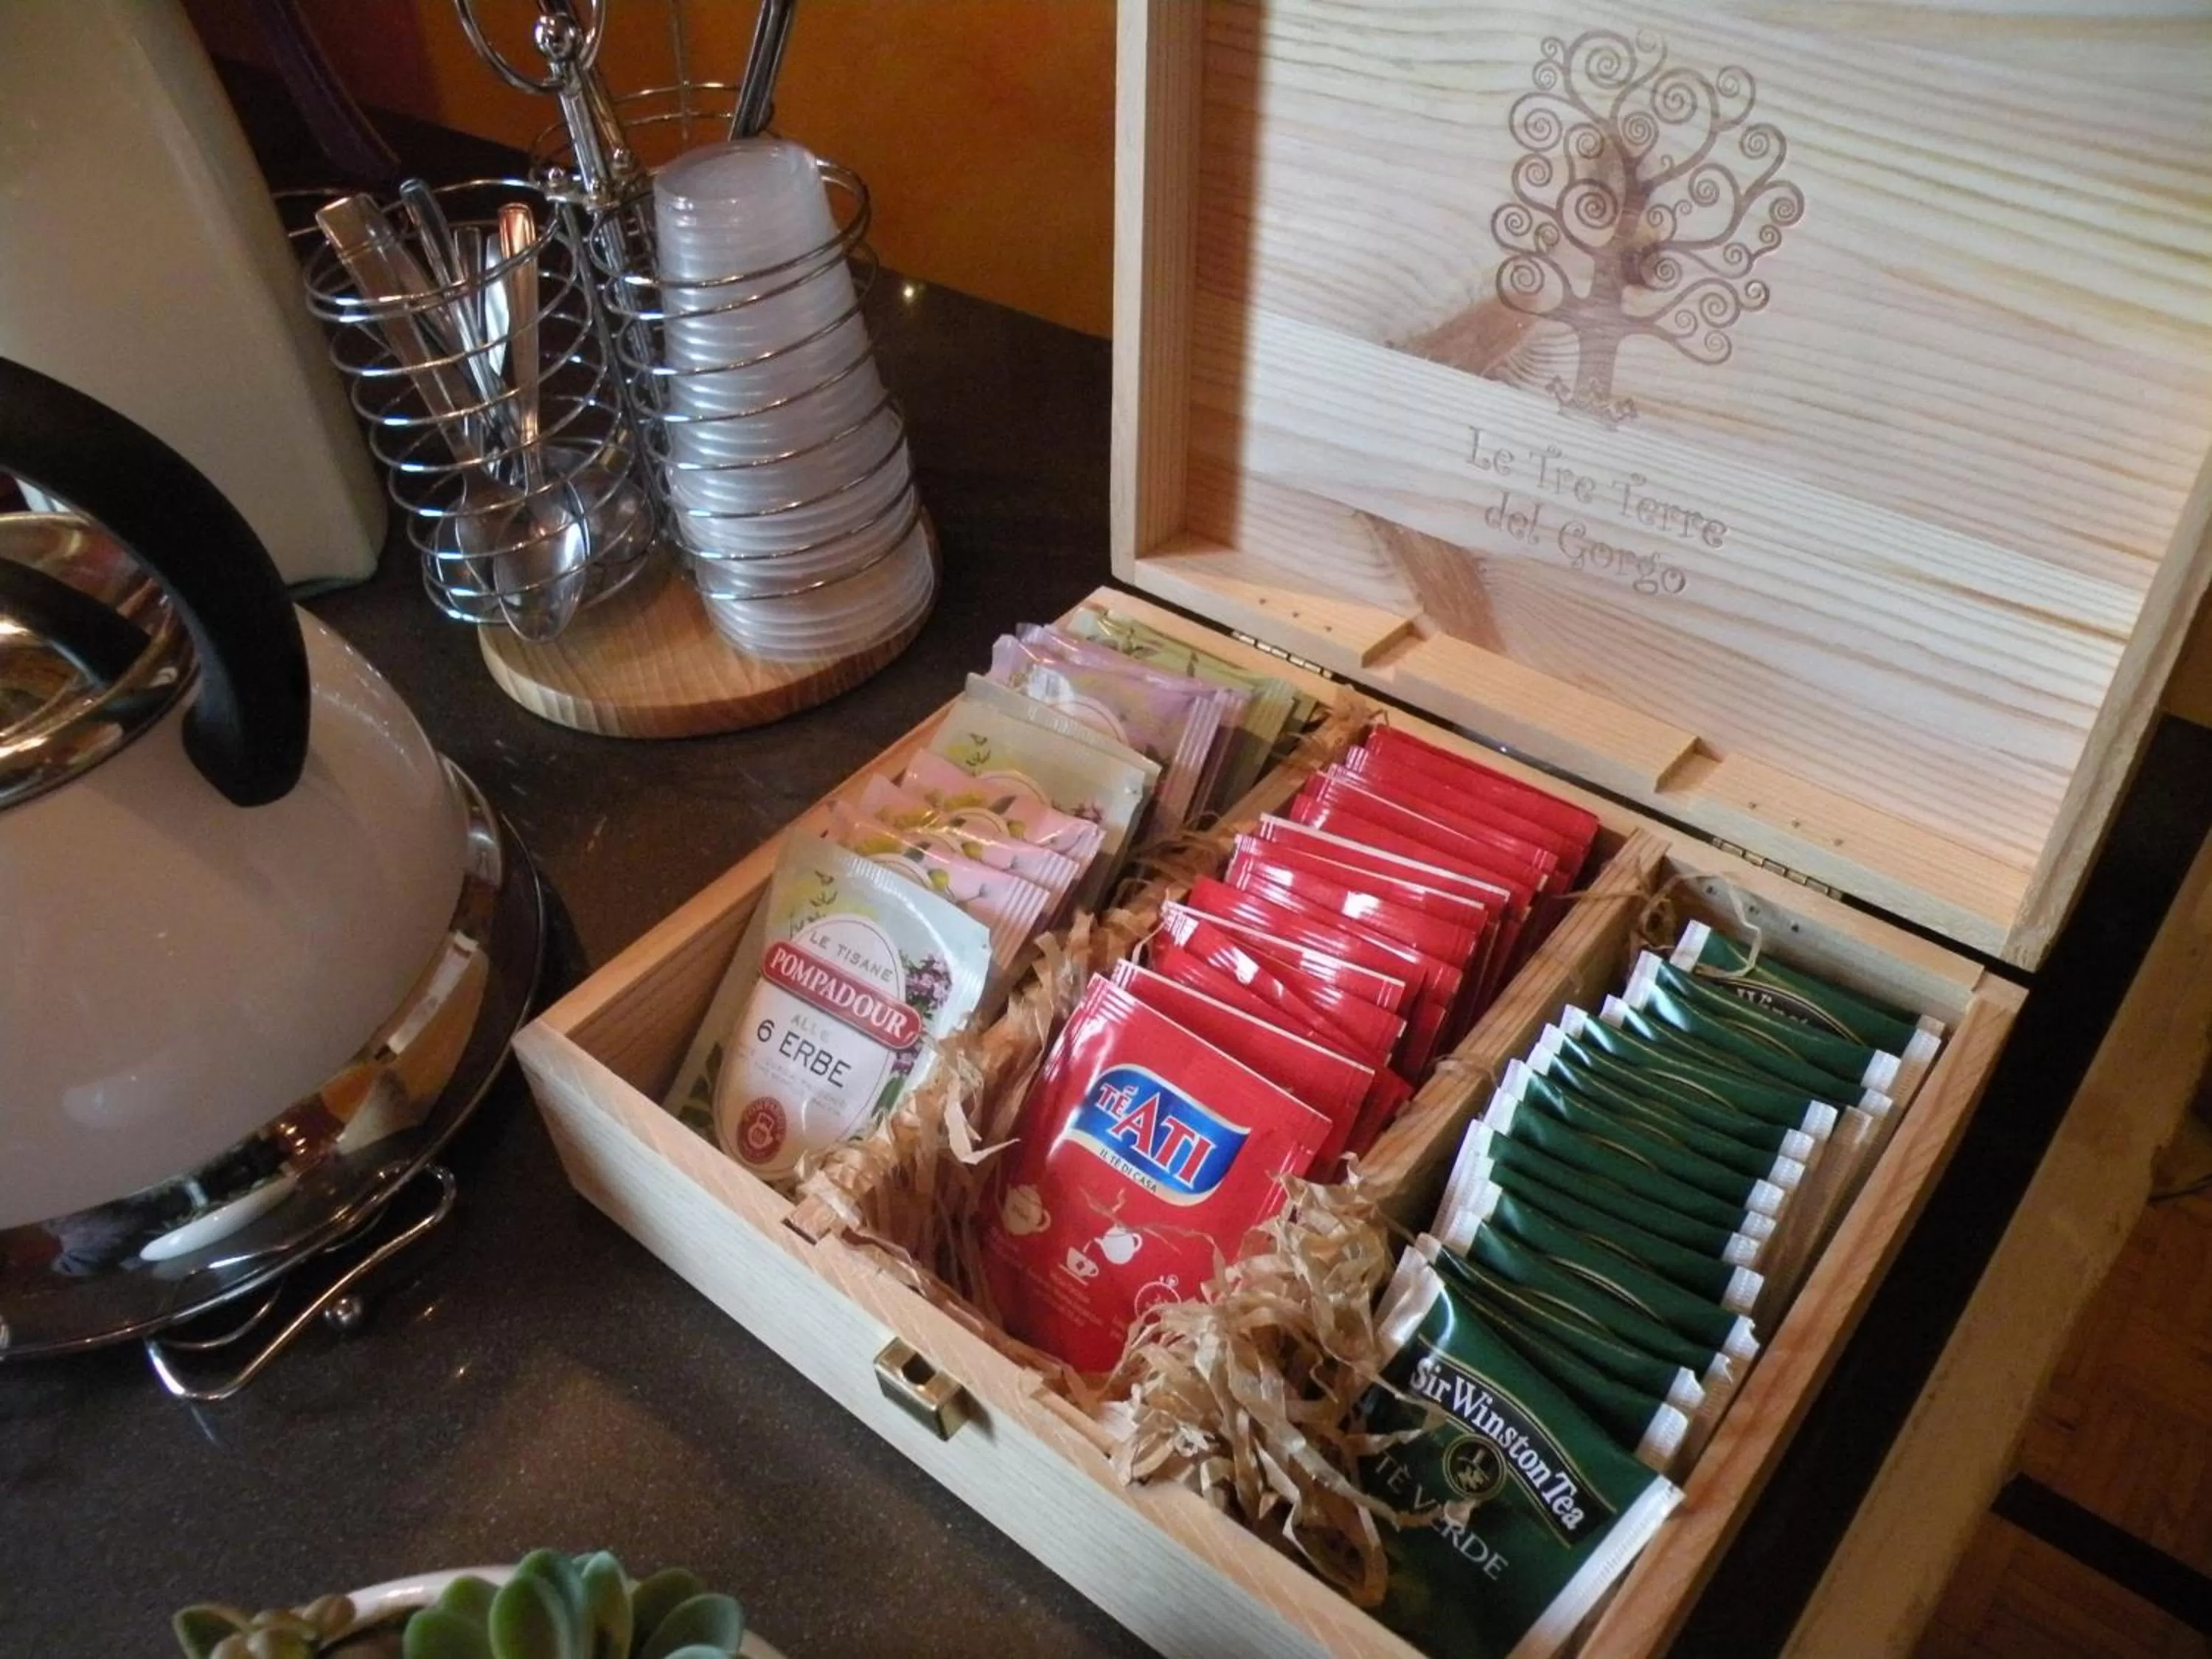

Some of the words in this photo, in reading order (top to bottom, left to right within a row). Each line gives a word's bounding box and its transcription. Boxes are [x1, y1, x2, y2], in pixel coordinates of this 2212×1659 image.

[1466, 425, 1515, 476] Le
[1529, 445, 1596, 504] Tre
[1607, 473, 1728, 548] Terre
[1484, 492, 1544, 544] del
[1558, 521, 1687, 595] Gorgo
[770, 947, 909, 1039] POMPADOUR
[808, 930, 830, 951] LE
[837, 942, 894, 981] TISANE
[757, 1019, 775, 1042] 6
[779, 1030, 852, 1088] ERBE
[1106, 1091, 1217, 1190] ATI
[1409, 1358, 1450, 1402] Sir
[1452, 1376, 1554, 1497] Winston
[1547, 1473, 1585, 1531] Tea
[1413, 1484, 1509, 1581] VRDE
